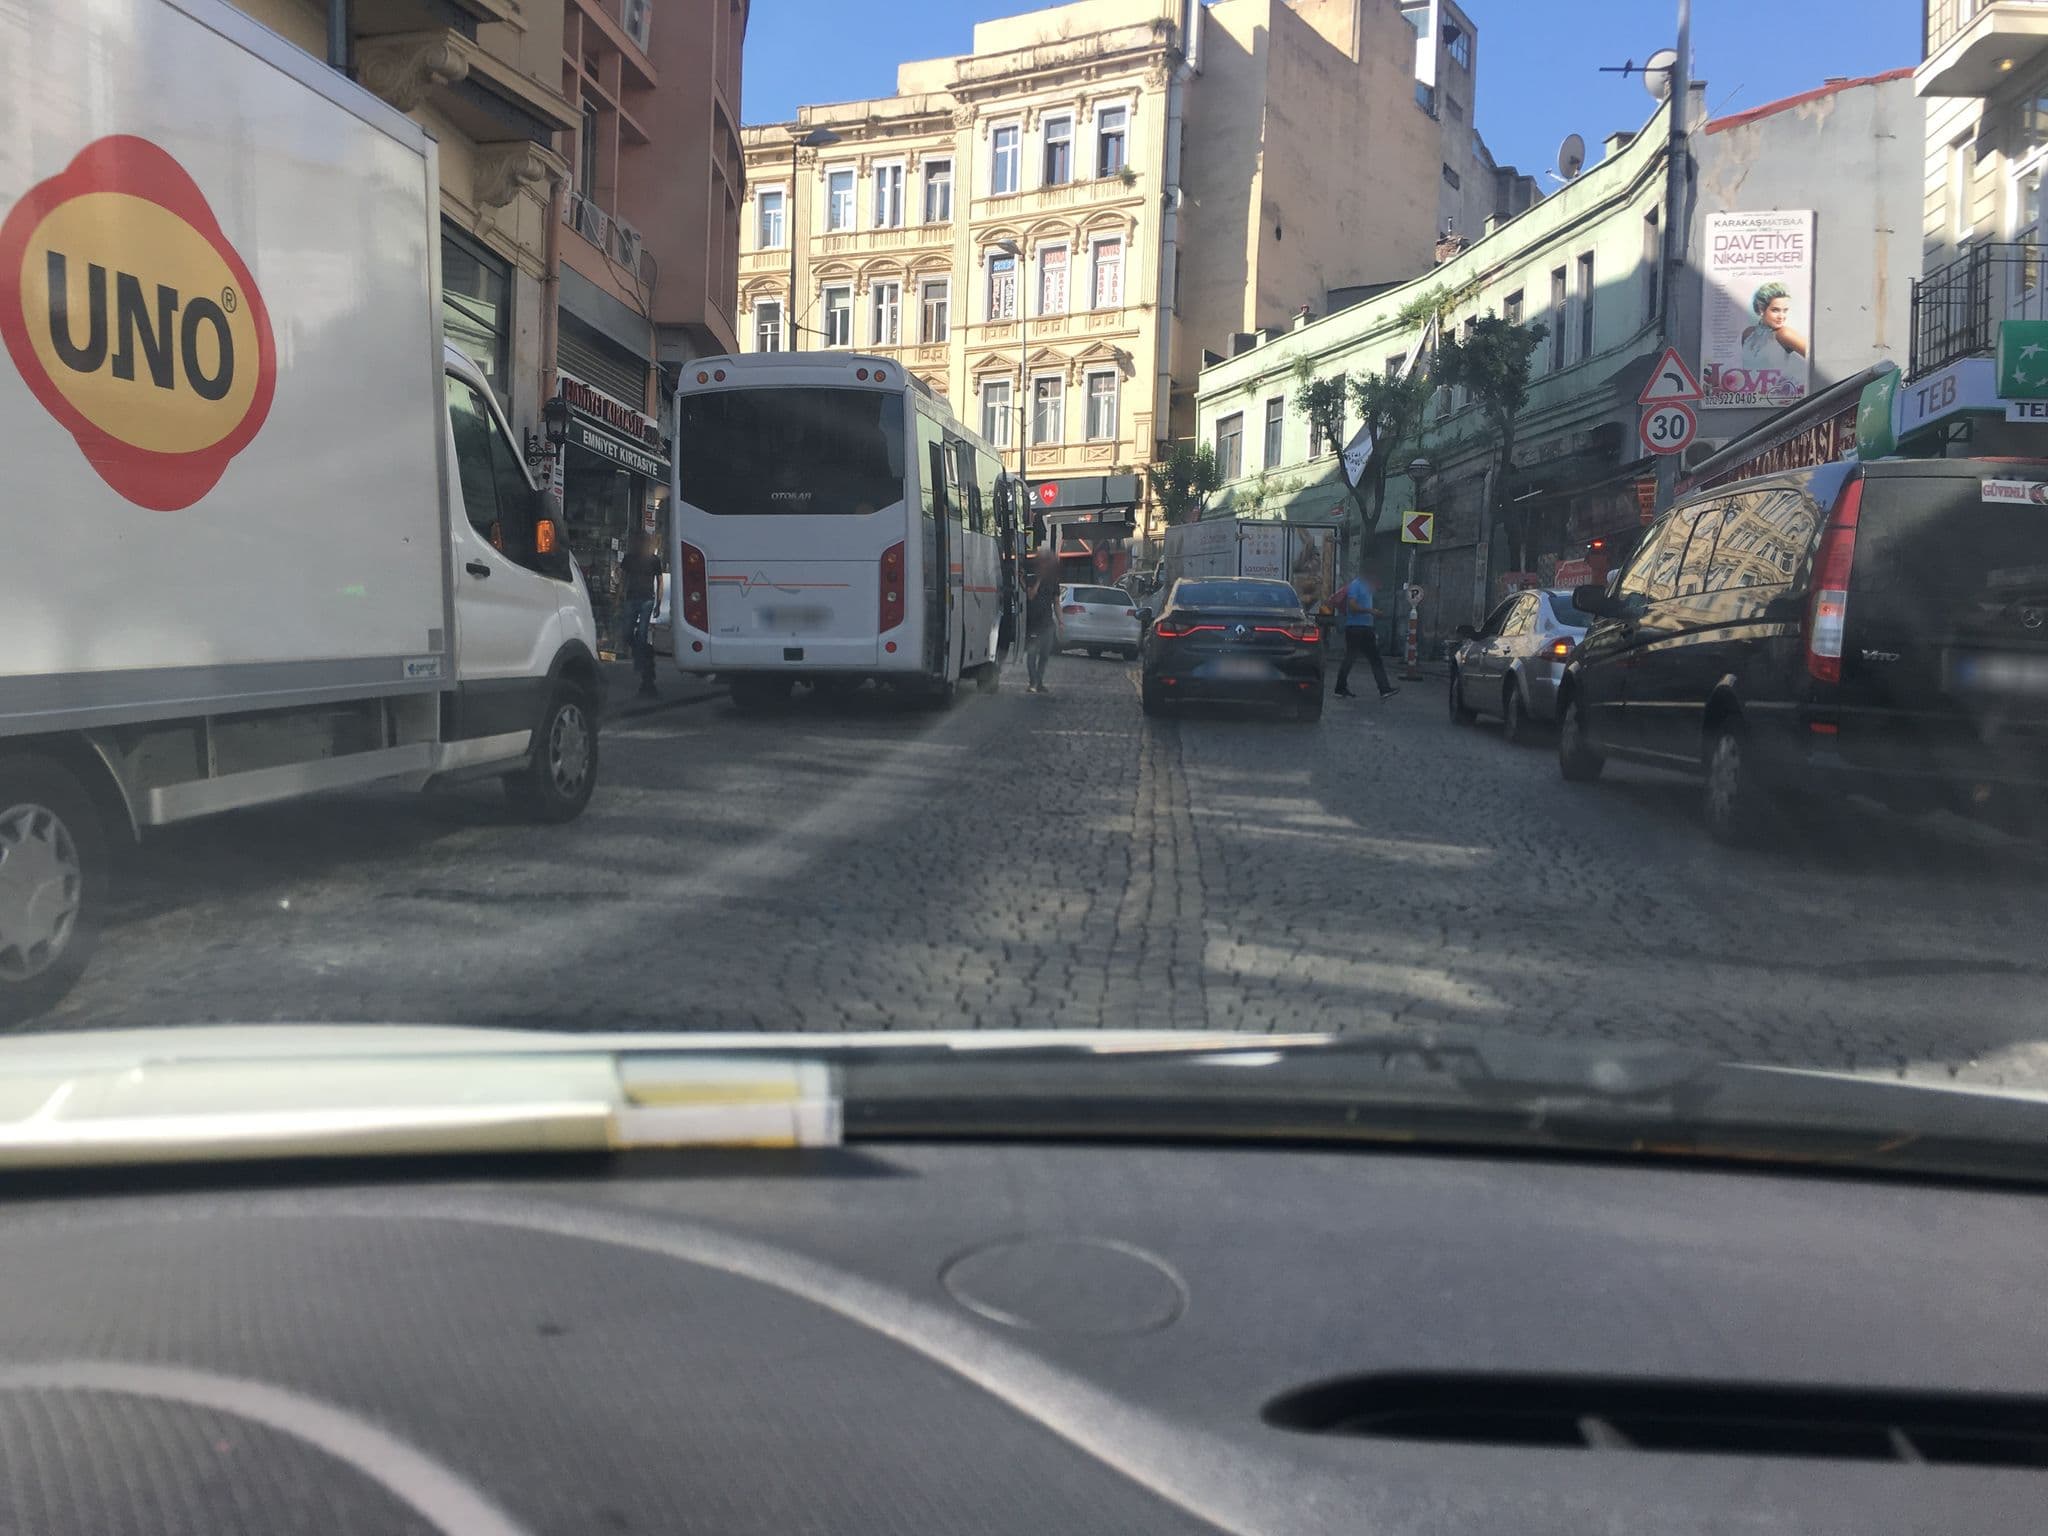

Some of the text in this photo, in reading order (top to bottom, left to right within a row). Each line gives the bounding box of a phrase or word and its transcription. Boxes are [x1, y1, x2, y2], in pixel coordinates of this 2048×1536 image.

[1714, 231, 1804, 251] DAVETİYE
[1713, 249, 1804, 265] NİKAH ŞEKERİ
[1917, 375, 1957, 418] TEB
[2015, 402, 2048, 418] TE
[1652, 414, 1685, 440] 30
